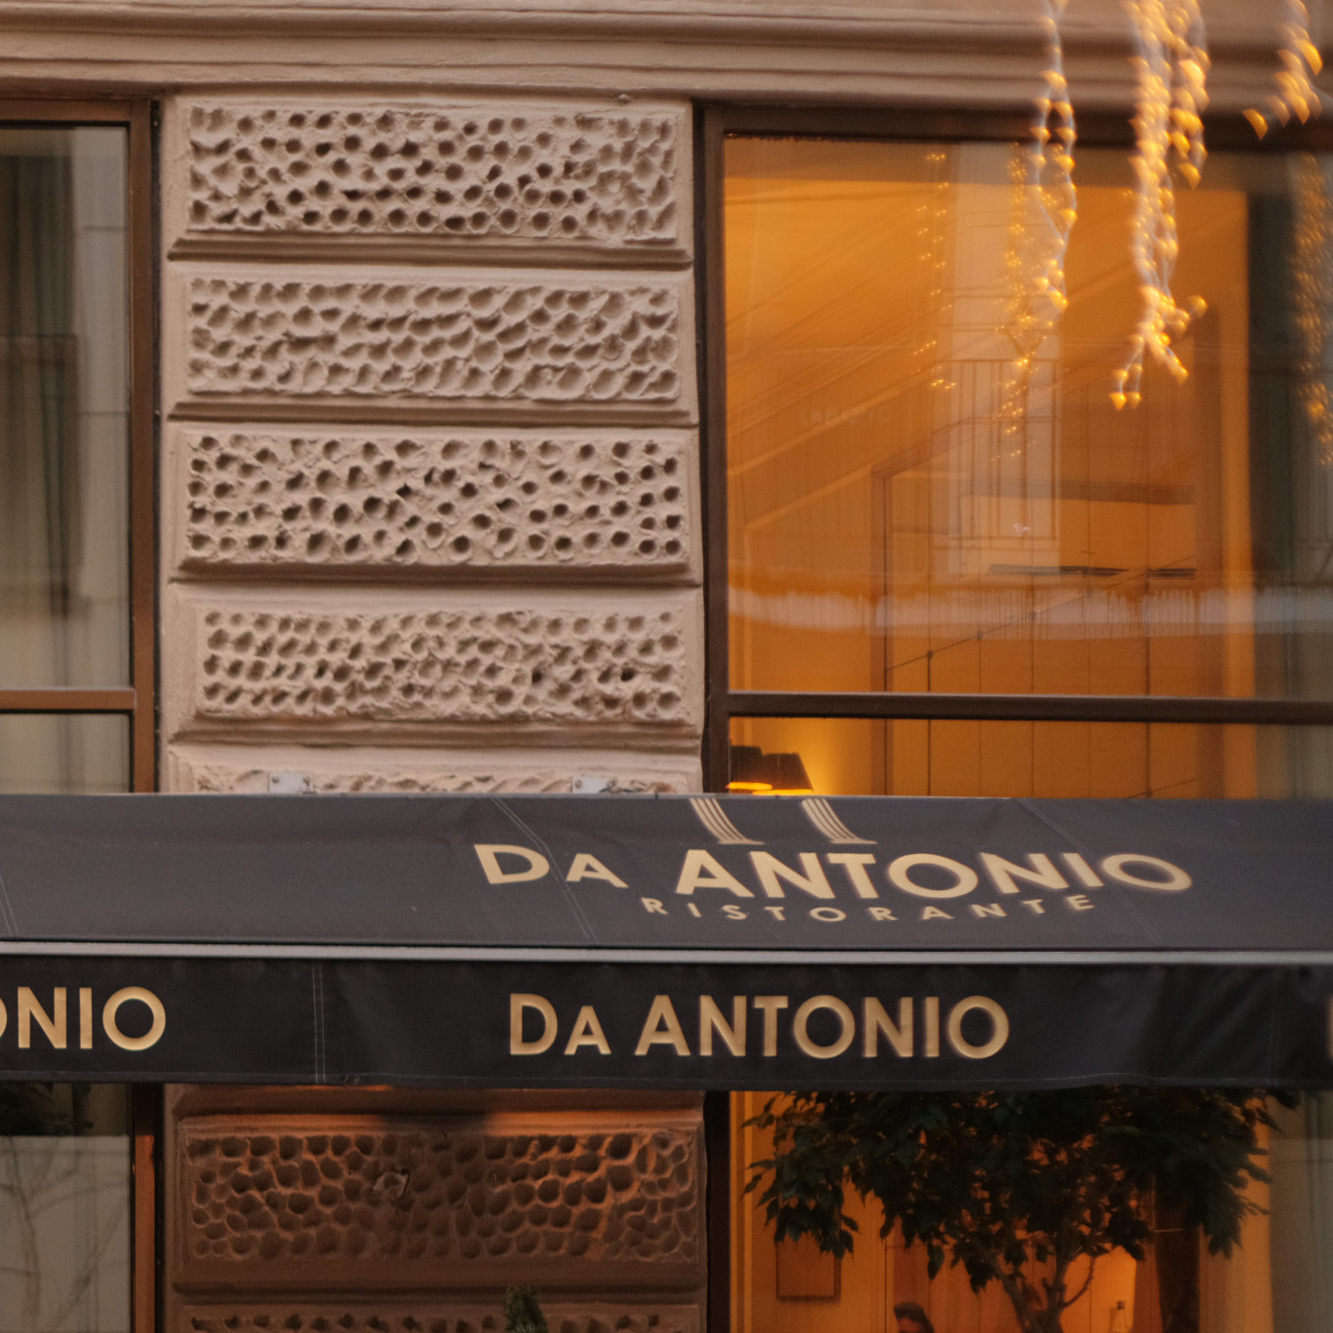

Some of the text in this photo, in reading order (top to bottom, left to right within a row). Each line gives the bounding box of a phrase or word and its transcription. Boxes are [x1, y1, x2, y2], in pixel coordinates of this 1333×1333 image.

[473, 843, 1193, 900] DA ANTONIO
[640, 893, 1095, 923] RISTORANTE
[509, 993, 1009, 1059] DA ANTONIO
